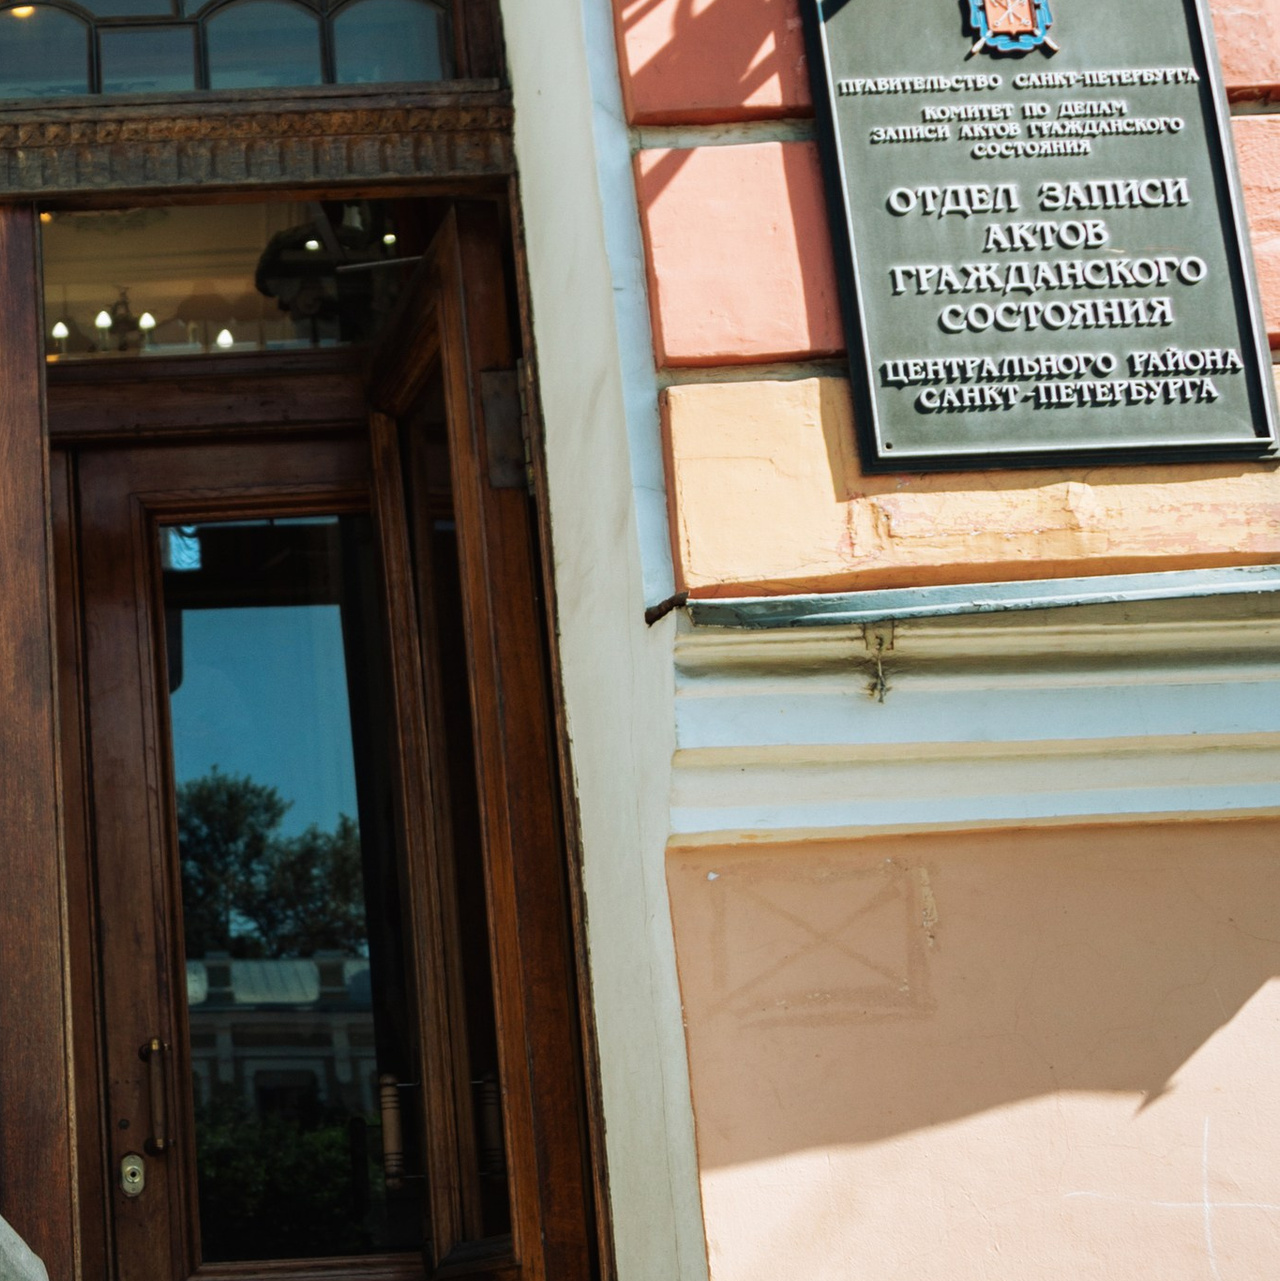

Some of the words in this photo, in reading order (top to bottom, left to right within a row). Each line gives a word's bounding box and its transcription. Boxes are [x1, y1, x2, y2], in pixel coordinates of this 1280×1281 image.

[840, 74, 1002, 94] ПРАВИТЕЛЬСТВО
[1014, 68, 1199, 87] САНКТ-ПЕТЕРБУРГА
[923, 104, 1014, 120] КОМИТЕТ
[1024, 103, 1051, 118] ПО
[1059, 101, 1128, 118] ДЕЛАМ
[871, 124, 950, 142] ЗАПИСИ
[961, 122, 1020, 138] АКТОВ
[1028, 118, 1184, 138] ГРАЖДАНСКОГО
[972, 139, 1091, 157] СОСТОЯНИЯ
[889, 185, 1019, 216] ОТДЕЛ
[1041, 178, 1191, 209] ЗАПИСИ
[987, 220, 1109, 250] АКТОВ
[892, 256, 1207, 294] ГРАЖДАНСКОГО
[941, 297, 1173, 331] СОСТОЯНИЯ
[885, 352, 1117, 383] ЦЕНТРАЛЬНОГО
[1130, 348, 1243, 371] РАЙОНА
